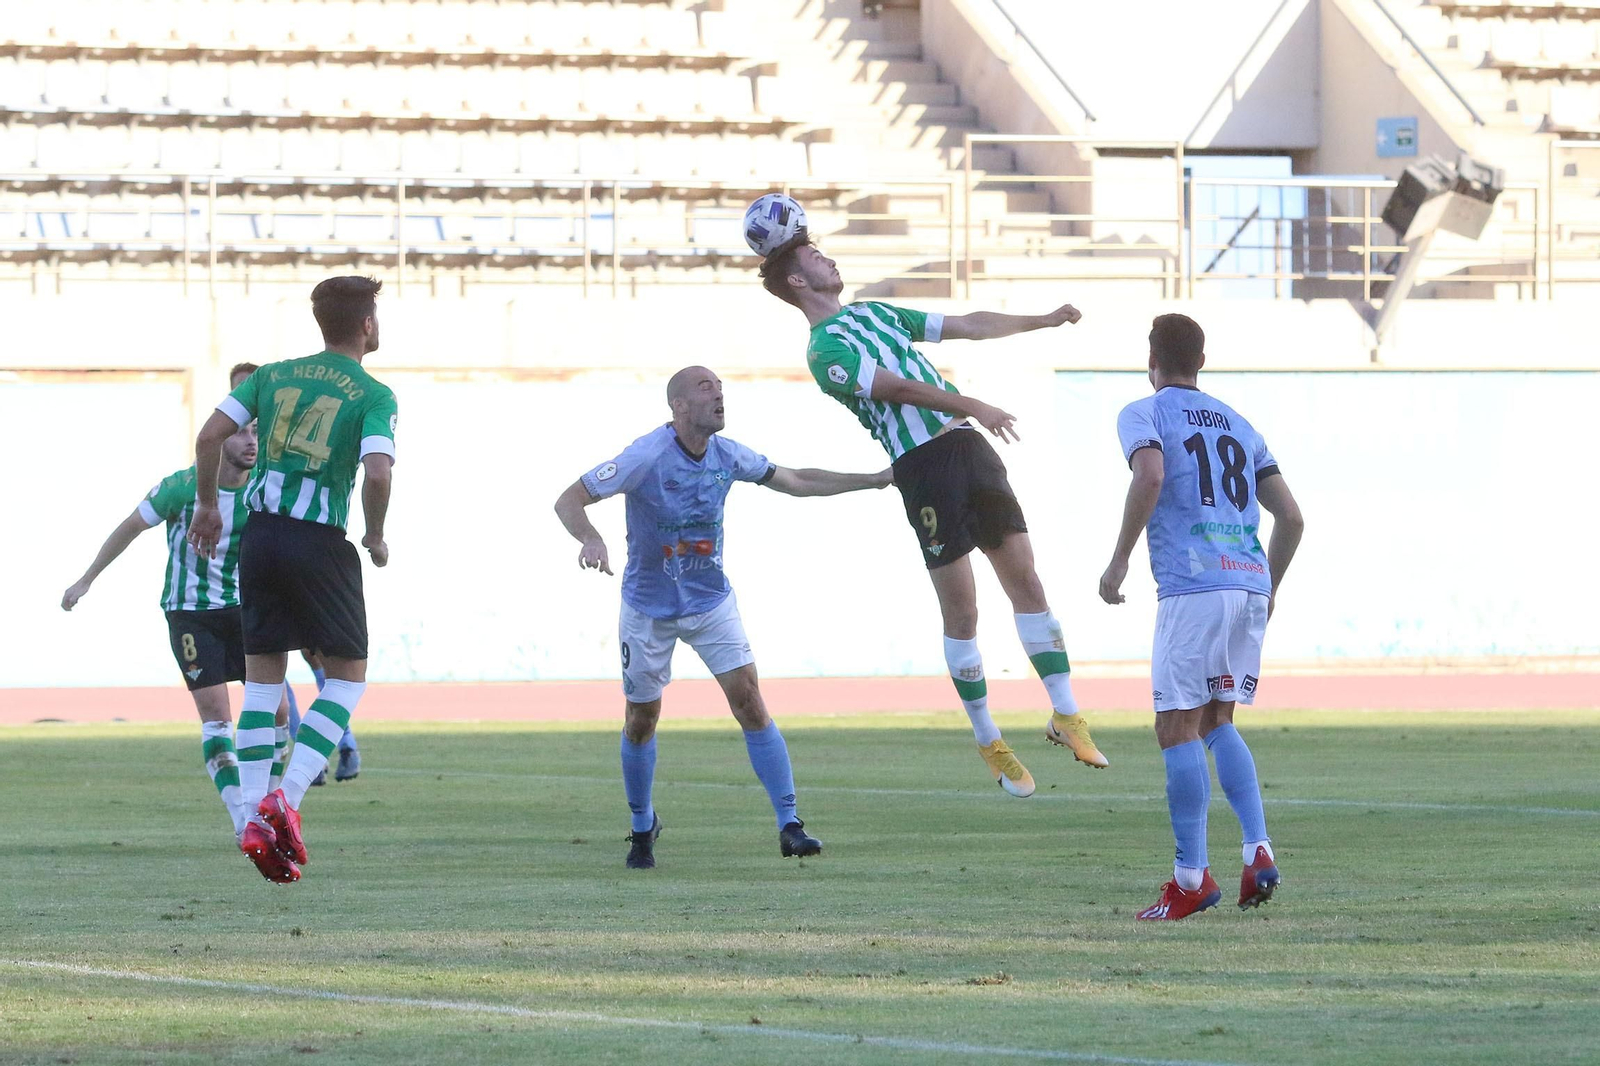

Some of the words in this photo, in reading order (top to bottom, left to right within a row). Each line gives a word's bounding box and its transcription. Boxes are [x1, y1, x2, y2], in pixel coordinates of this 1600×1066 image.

[293, 365, 364, 401] HERMOSO
[266, 386, 343, 472] 14
[1182, 409, 1231, 431] ZUBIRI
[1183, 432, 1249, 512] 18
[920, 506, 938, 538] 9
[1190, 521, 1242, 536] avanza
[1220, 554, 1265, 575] fircosa
[181, 633, 198, 662] 8
[621, 641, 631, 670] 9
